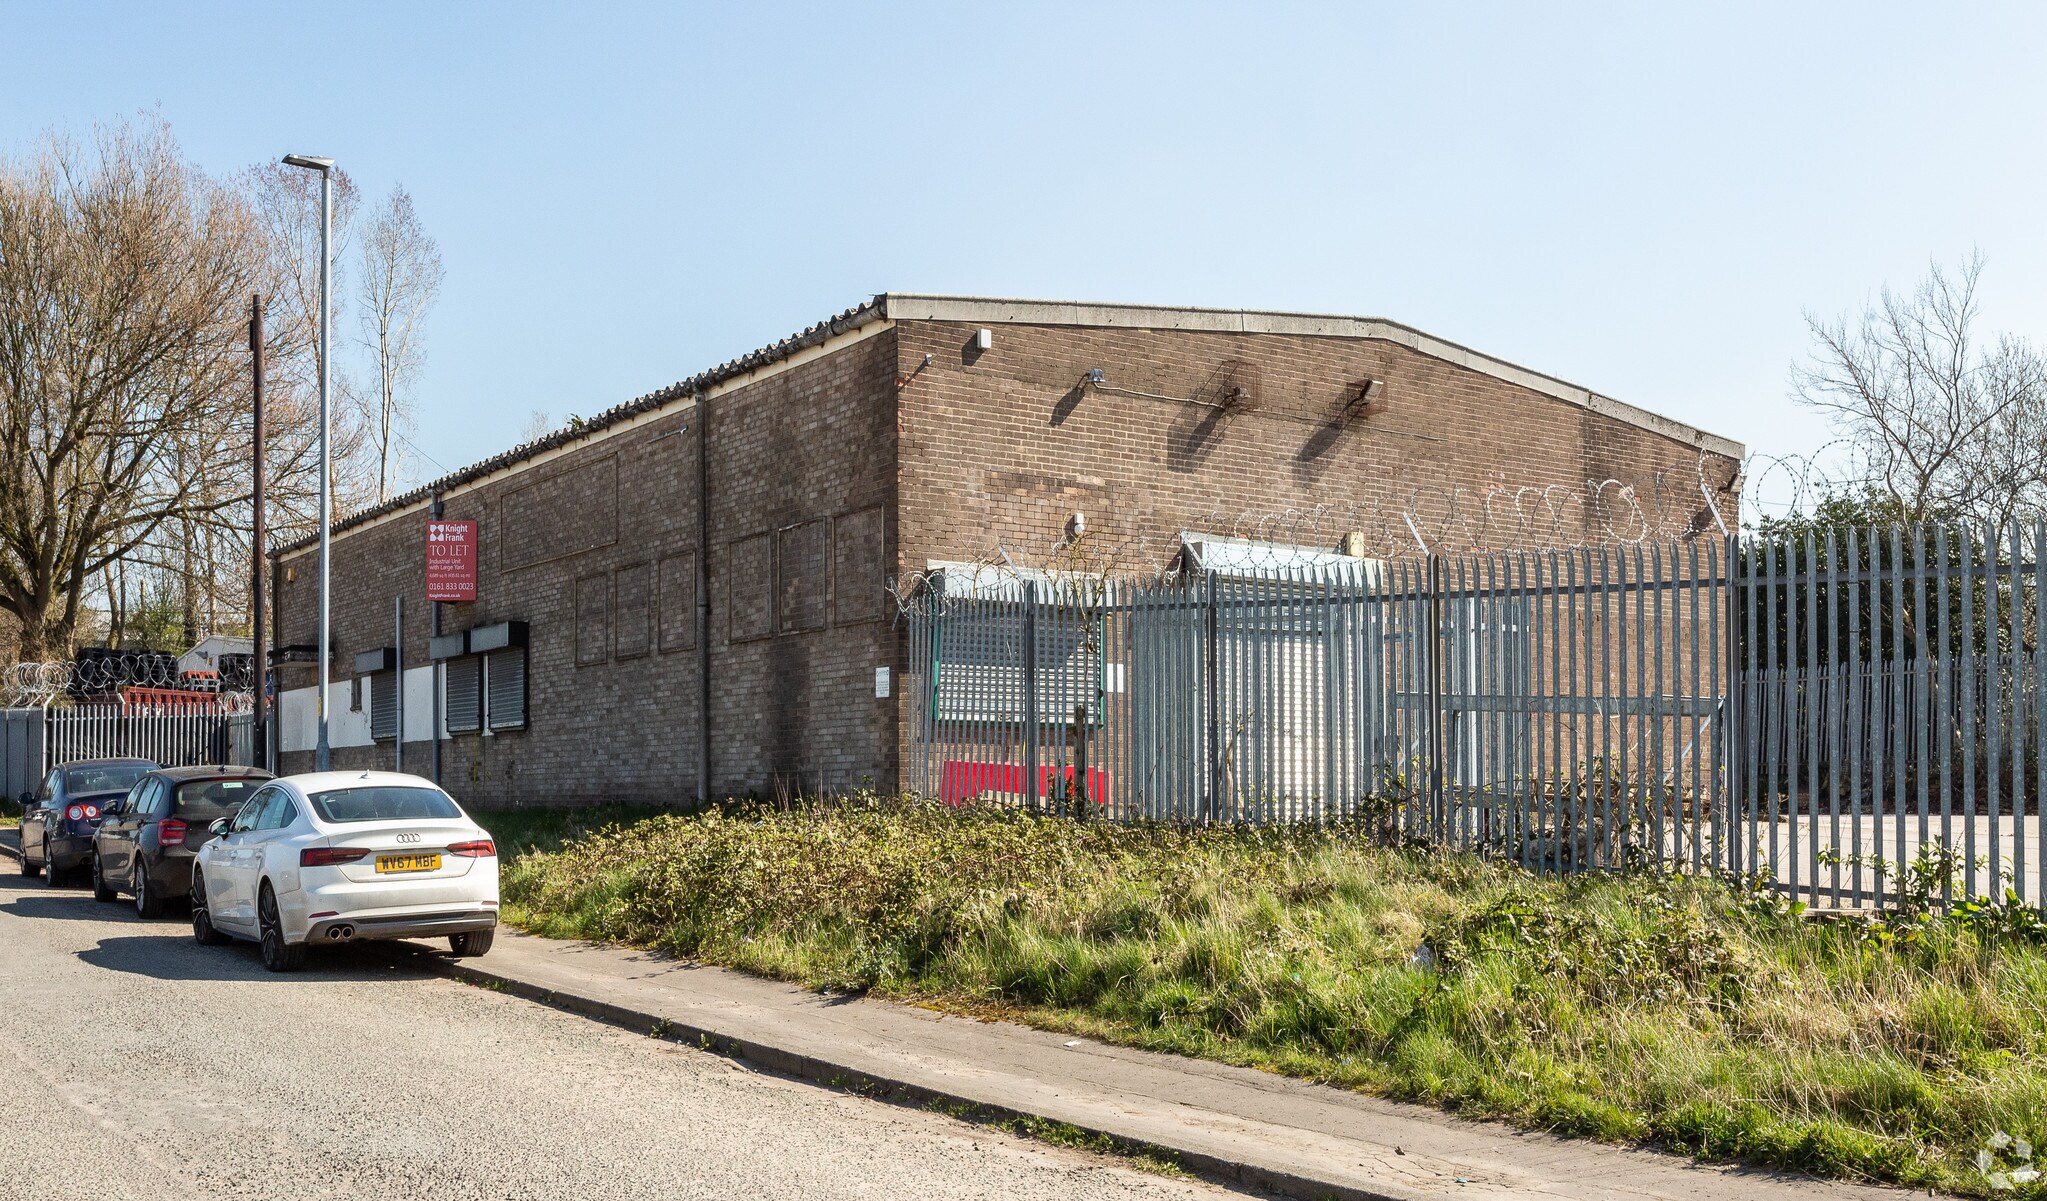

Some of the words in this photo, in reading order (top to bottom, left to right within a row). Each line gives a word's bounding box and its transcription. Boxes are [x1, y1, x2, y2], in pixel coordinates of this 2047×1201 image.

[445, 524, 468, 534] Knight
[430, 545, 446, 556] TO
[450, 545, 469, 556] LET
[429, 582, 444, 590] 0161
[446, 582, 457, 590] 833
[459, 582, 474, 590] 0023
[415, 855, 437, 868] MBF
